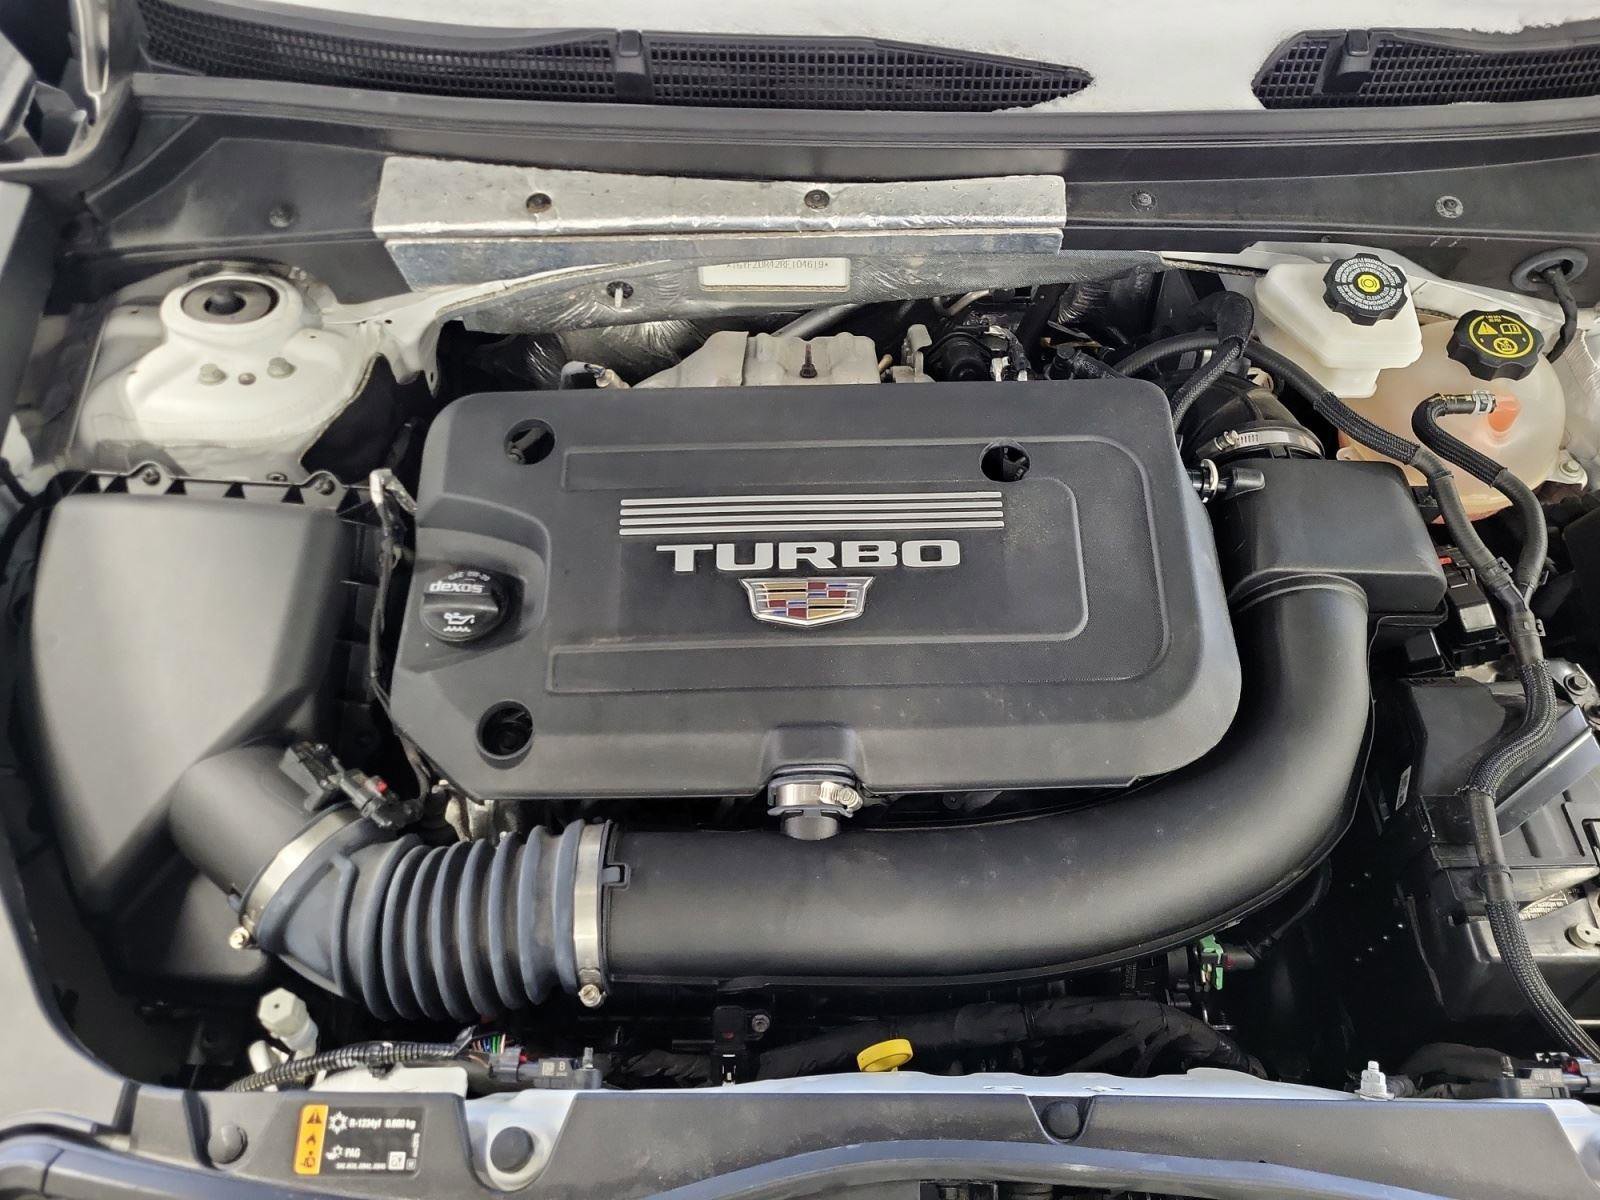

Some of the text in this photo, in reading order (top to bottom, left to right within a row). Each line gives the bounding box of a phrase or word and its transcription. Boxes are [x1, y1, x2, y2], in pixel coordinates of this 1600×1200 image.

[655, 540, 961, 573] TURBO
[429, 580, 484, 593] dexos
[344, 1147, 361, 1158] PAG
